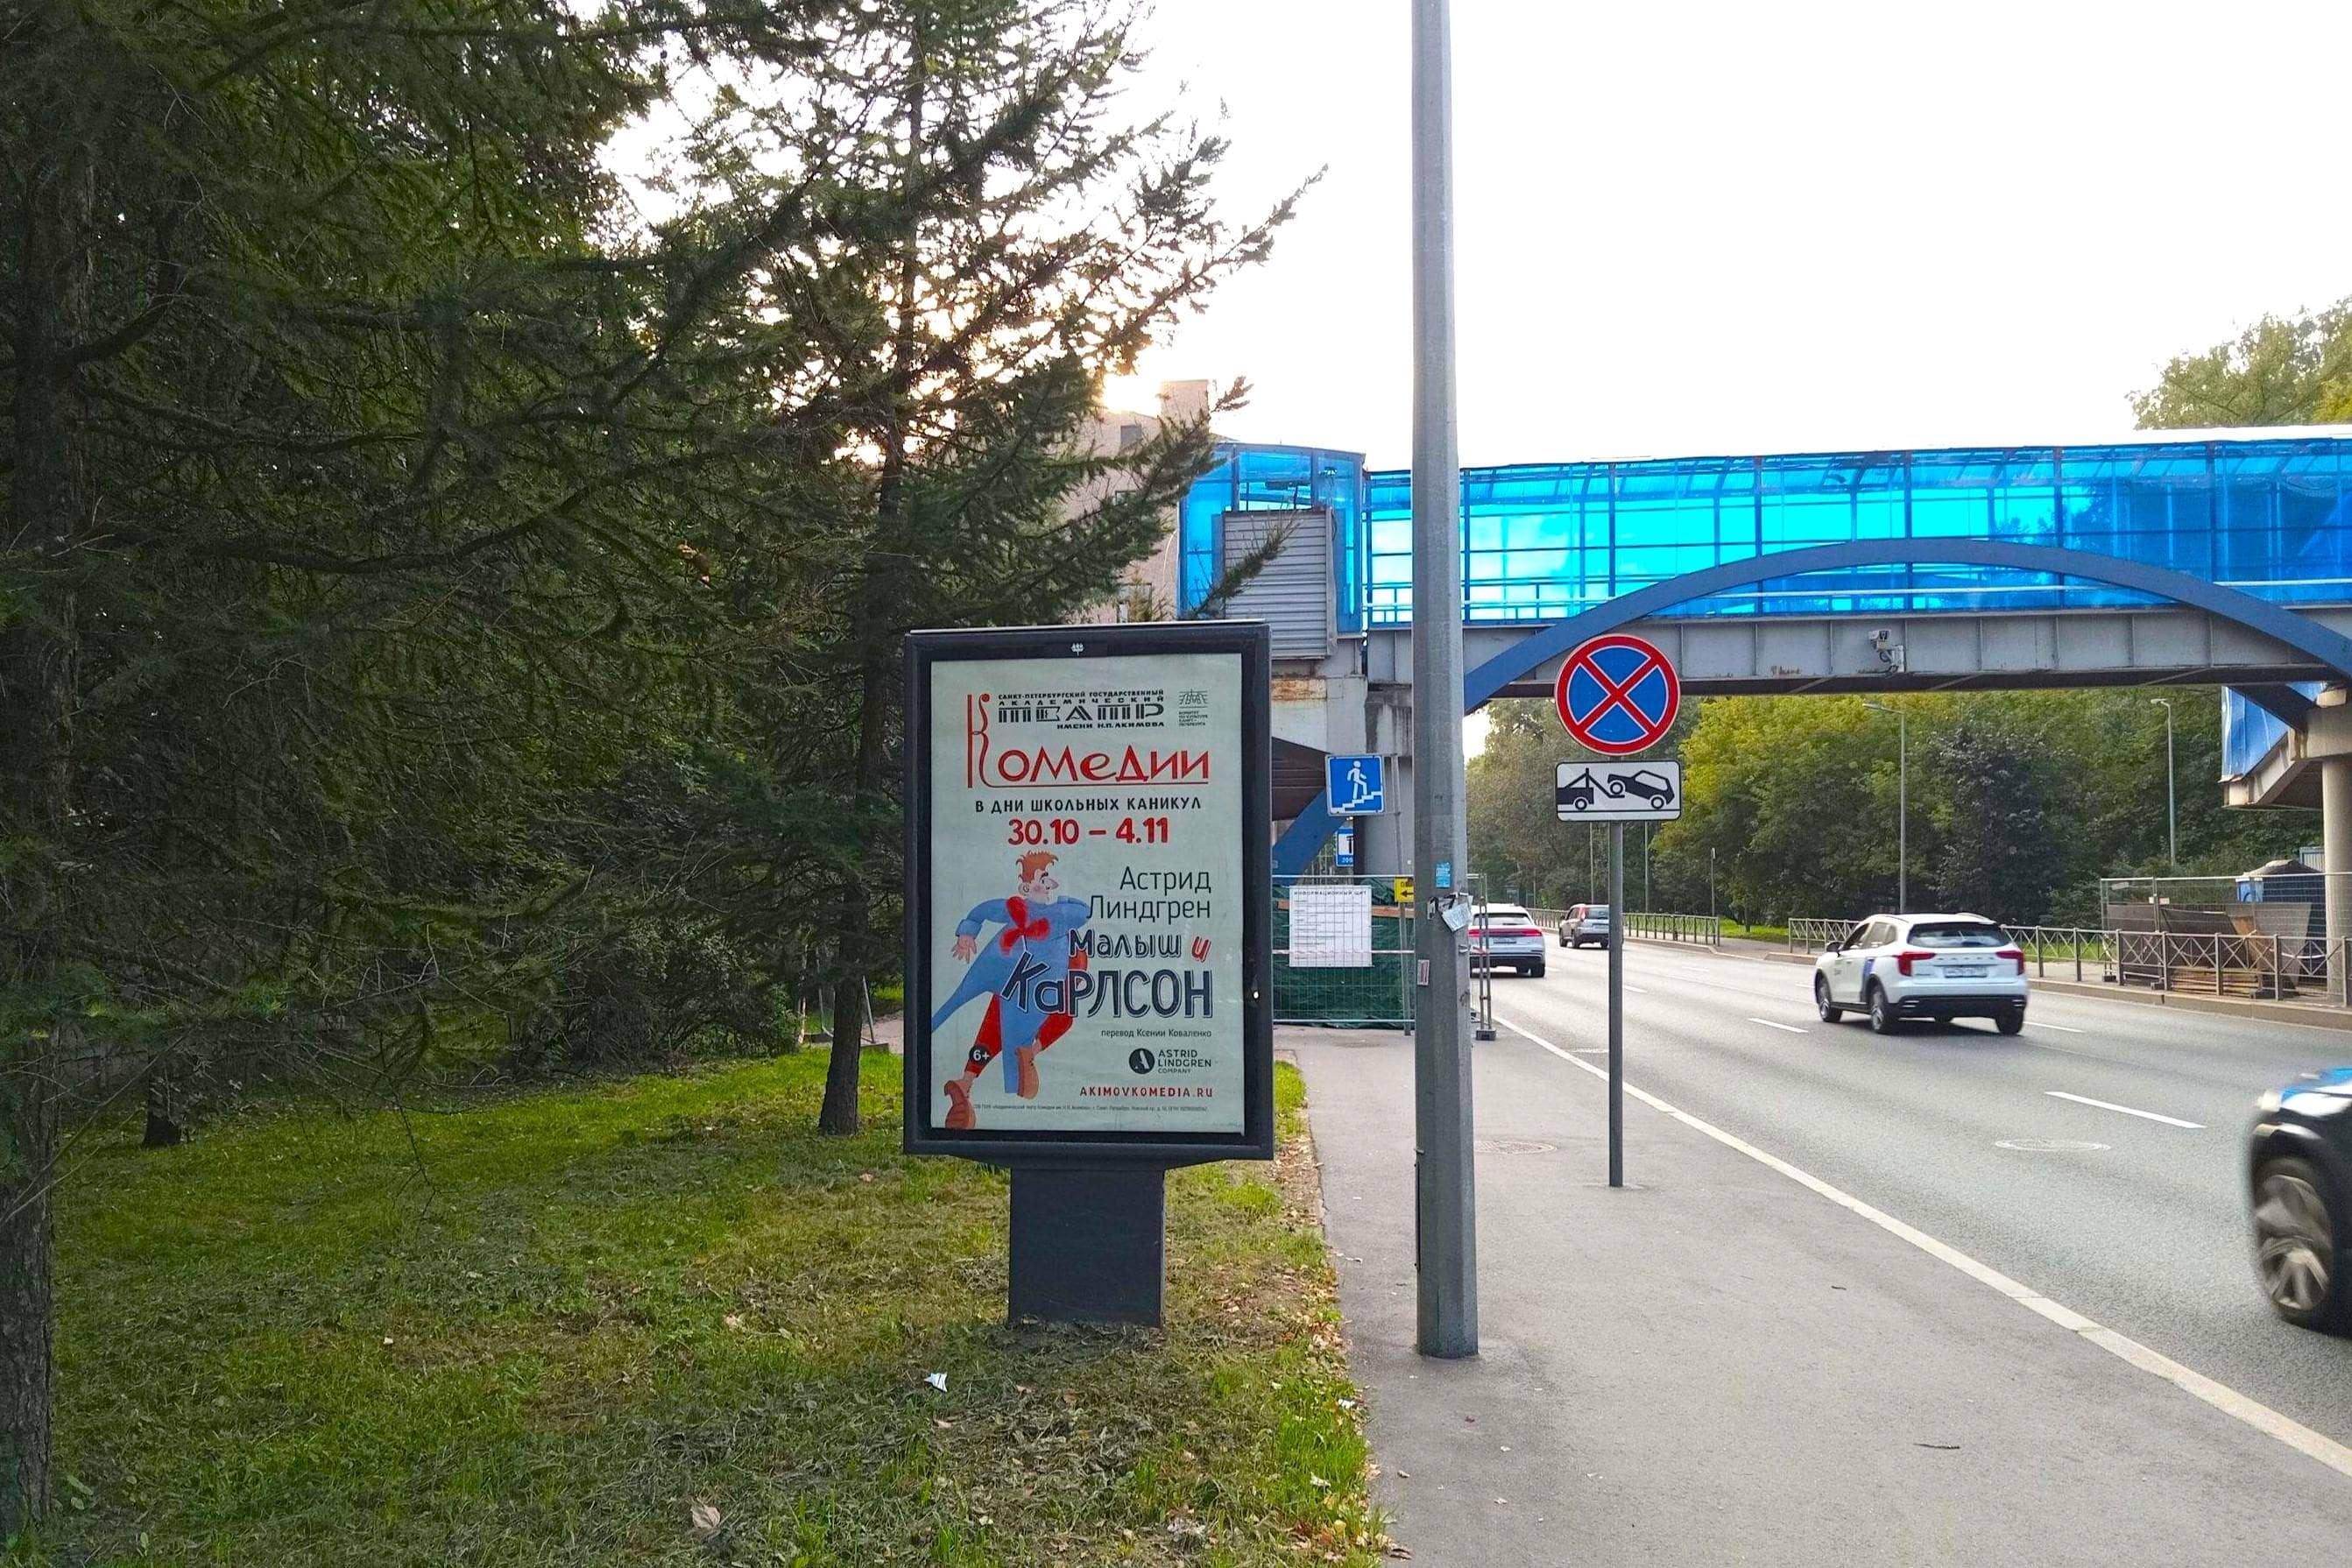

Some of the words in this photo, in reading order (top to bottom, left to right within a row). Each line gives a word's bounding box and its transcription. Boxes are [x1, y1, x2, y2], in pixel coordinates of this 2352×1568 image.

[999, 690, 1085, 700] САНКТ-ПЕТЕРБУРГСКИЙ
[1089, 689, 1164, 697] ГОСУДАРСТВЕННЫЙ
[999, 696, 1164, 706] АКАДЕМИЧЕСКИЙ
[999, 703, 1164, 723] ТЕАТР
[976, 800, 984, 813] В
[991, 798, 1023, 814] ДНИ
[1031, 798, 1119, 812] ШКОЛЬНЫХ
[1127, 797, 1201, 810] КАНИКУЛ
[1007, 818, 1079, 845] 30.10
[1115, 817, 1169, 844] 4.11
[1119, 865, 1211, 896] Астрид
[1086, 895, 1211, 924] Линдгрен
[1101, 1029, 1134, 1039] перевод
[1136, 1028, 1166, 1037] Ксении
[1169, 1028, 1211, 1037] Коваленко
[973, 1049, 990, 1061] 6+
[1158, 1049, 1197, 1058] ASTRID
[1158, 1058, 1211, 1067] LINDGREN
[1079, 1086, 1212, 1098] AKIMOVKOMEDIA.RU
